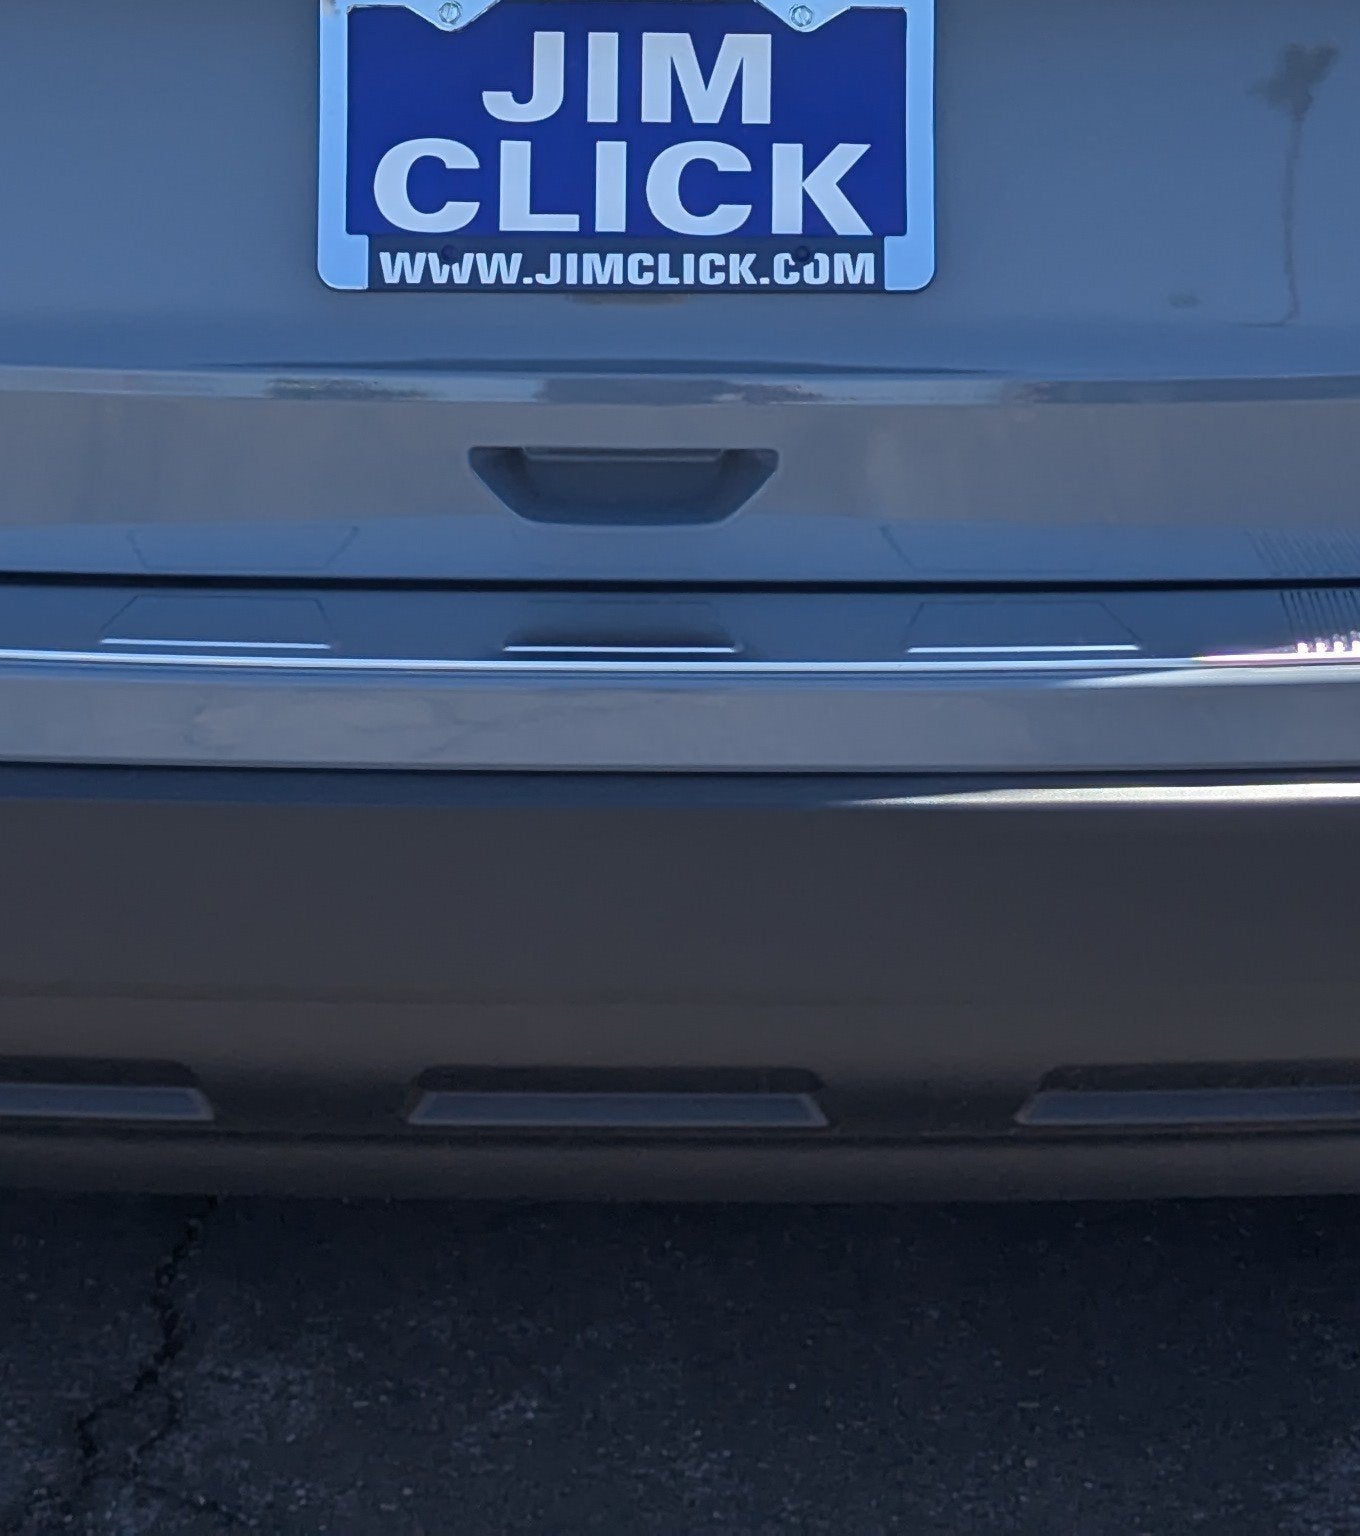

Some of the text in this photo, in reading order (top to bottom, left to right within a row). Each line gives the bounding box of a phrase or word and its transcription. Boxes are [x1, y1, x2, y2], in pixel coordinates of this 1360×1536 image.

[482, 31, 772, 125] JIM
[373, 137, 874, 237] CLICK
[379, 251, 876, 286] WWW.JIMCLICK.COM
